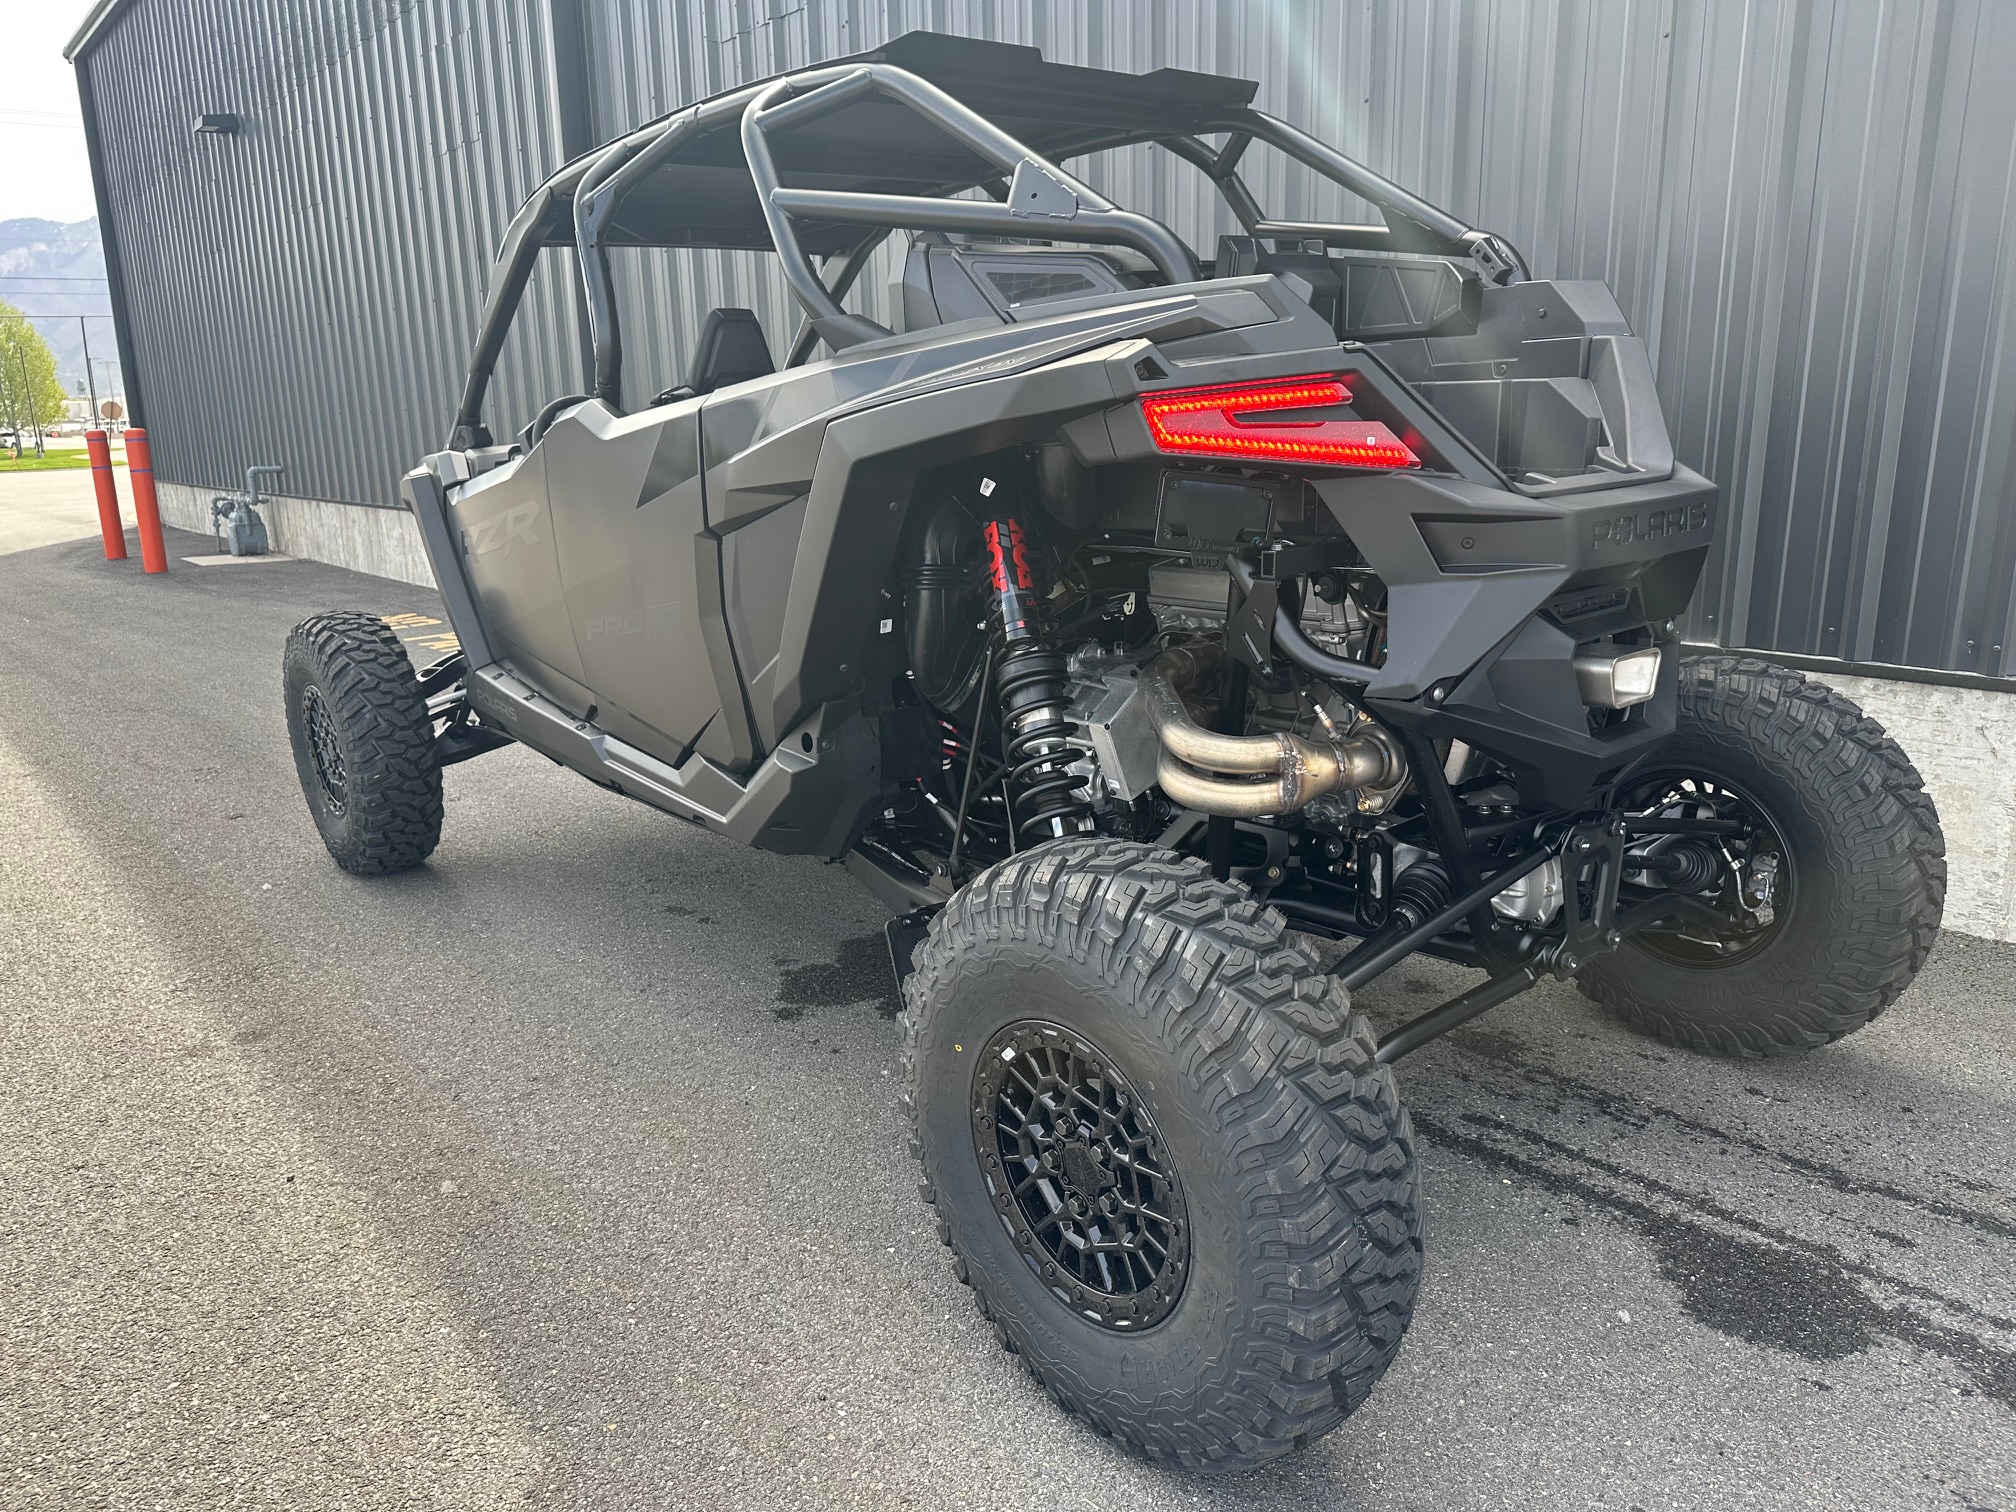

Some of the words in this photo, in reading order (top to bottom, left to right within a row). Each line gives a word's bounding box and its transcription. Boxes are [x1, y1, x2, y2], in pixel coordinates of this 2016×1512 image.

[461, 499, 543, 567] RZR
[1592, 502, 1707, 549] POLARIS
[475, 687, 518, 722] POLARIS
